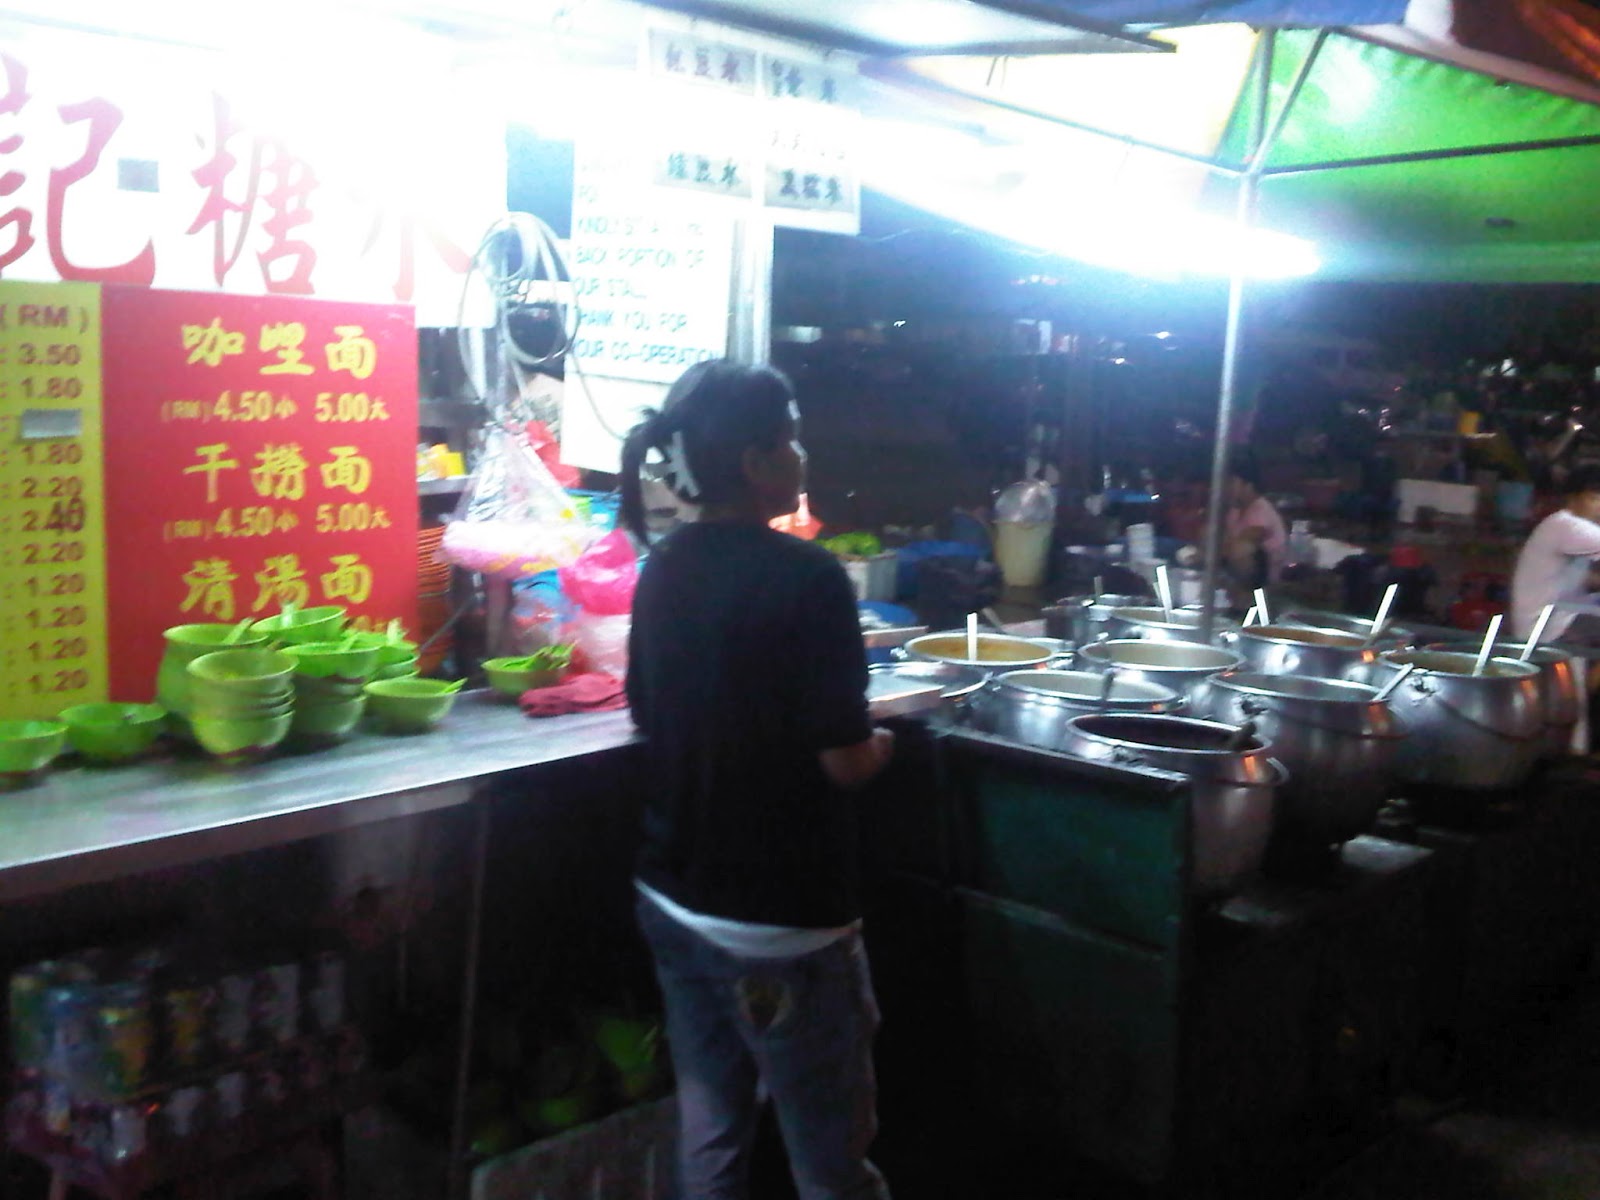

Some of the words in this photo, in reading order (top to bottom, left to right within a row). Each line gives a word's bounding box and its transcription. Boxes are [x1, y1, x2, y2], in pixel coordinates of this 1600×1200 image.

[576, 245, 608, 265] BACK
[617, 246, 677, 269] PORTION
[681, 247, 705, 269] OF
[623, 308, 651, 332] YOU
[658, 310, 688, 334] FOR
[19, 343, 81, 366] 3.50
[20, 376, 82, 399] 1.80
[21, 443, 83, 465] 1.80
[21, 475, 83, 499] 2.20
[22, 541, 85, 565] 2.20
[25, 573, 86, 596] 1.20
[26, 606, 87, 629] 1.20
[27, 637, 88, 661] 1.20
[27, 669, 89, 693] 1.20
